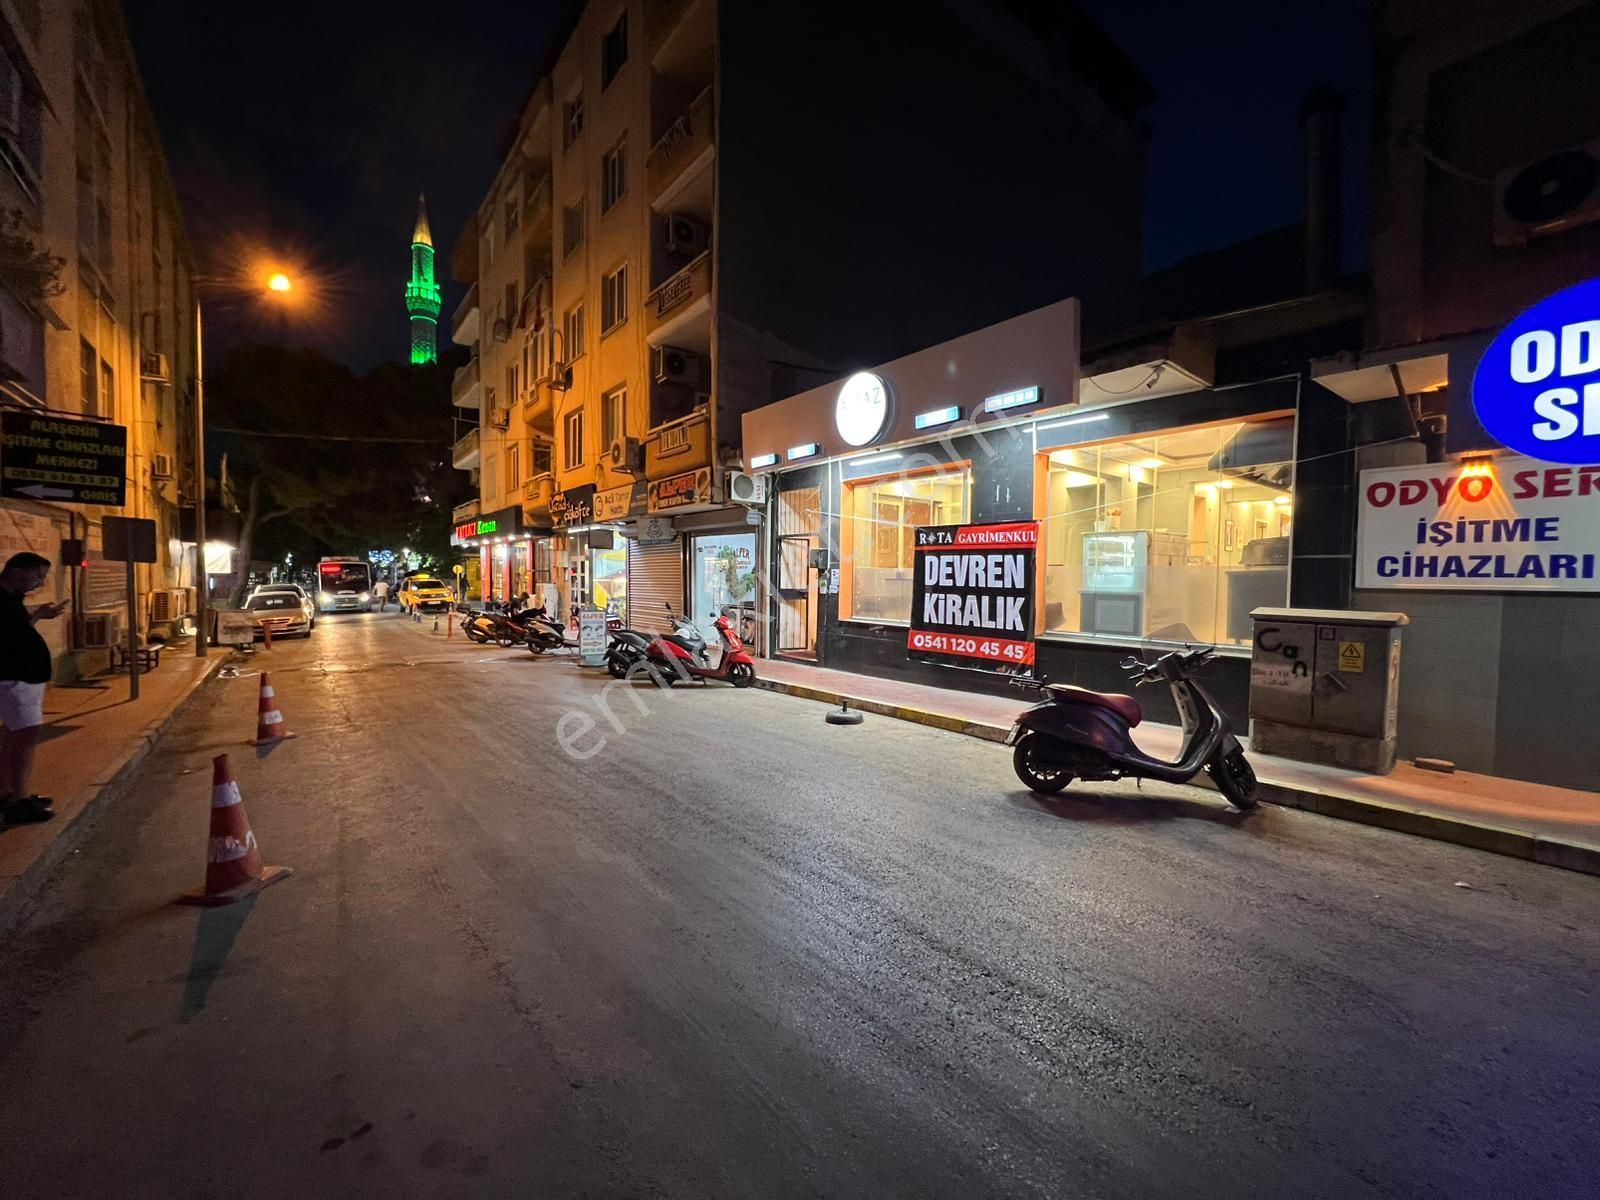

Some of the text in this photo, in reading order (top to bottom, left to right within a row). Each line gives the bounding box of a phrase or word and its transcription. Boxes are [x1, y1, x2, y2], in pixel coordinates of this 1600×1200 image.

[1366, 476, 1493, 508] ODYO
[958, 530, 1037, 544] GAYRİMENKUL
[1417, 516, 1560, 547] İŞİTME
[924, 555, 1025, 588] DEVREN
[1377, 551, 1595, 579] CİHAZLARI
[913, 634, 1024, 660] 0541 120 45 45
